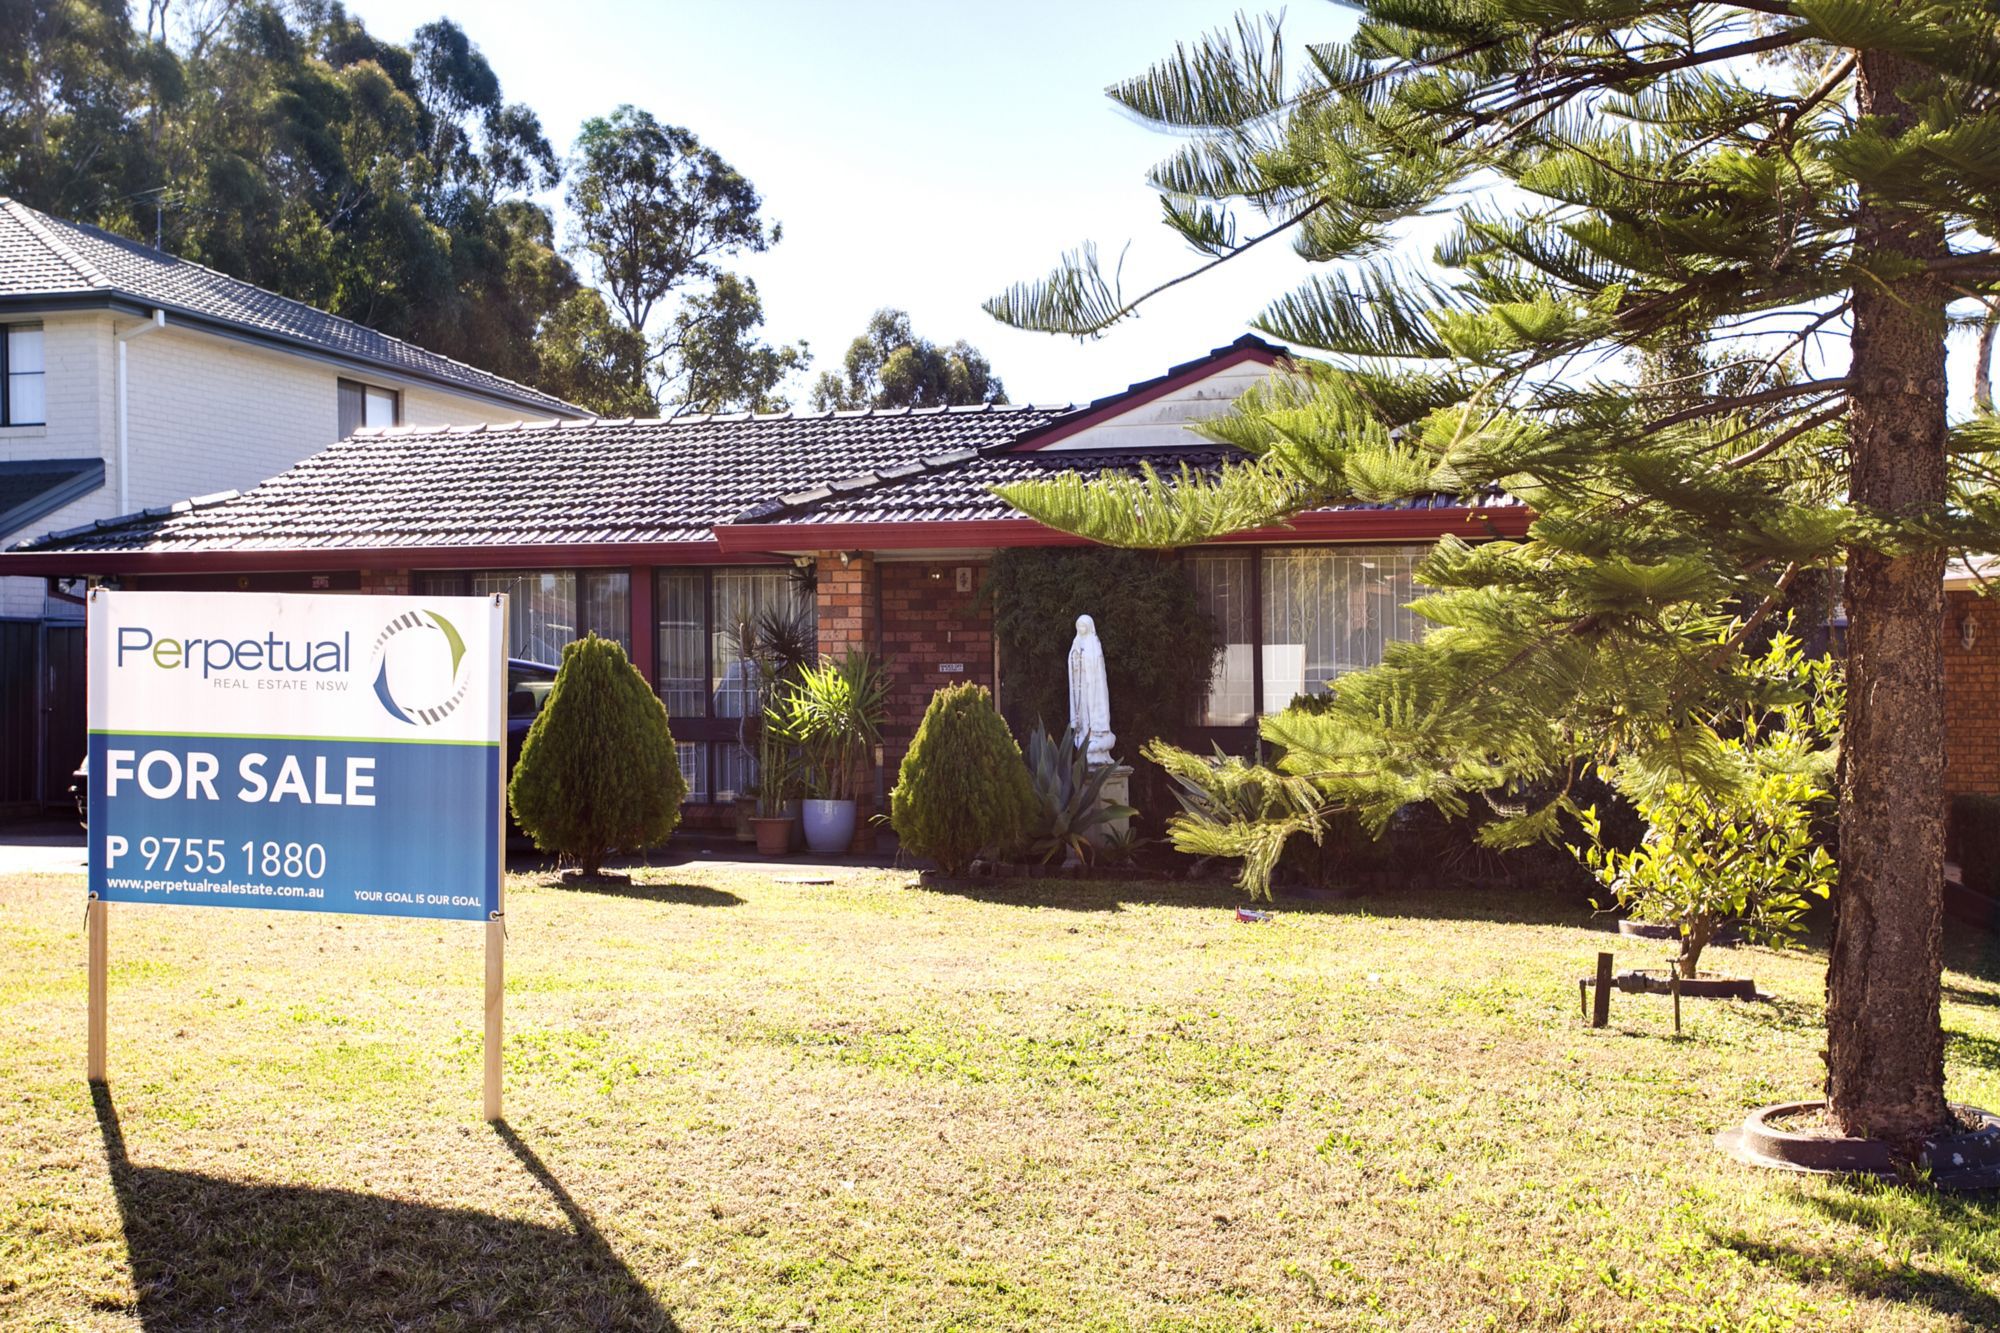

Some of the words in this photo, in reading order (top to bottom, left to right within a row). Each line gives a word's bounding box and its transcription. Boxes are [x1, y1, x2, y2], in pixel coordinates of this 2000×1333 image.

[118, 627, 350, 679] Perpetual
[213, 678, 249, 689] REAL
[257, 679, 308, 690] ESTATE
[316, 680, 349, 691] NSW
[106, 749, 220, 800] FOR
[237, 752, 376, 807] SALE
[106, 835, 129, 869] P
[140, 836, 226, 874] 9755
[241, 840, 326, 879] 1880
[107, 877, 324, 898] www.perpetualrealestate.com.au
[354, 890, 383, 902] YOUR
[384, 892, 414, 903] GOAL
[415, 893, 425, 904] IS
[427, 895, 450, 905] OUR
[452, 896, 481, 907] GOAL
